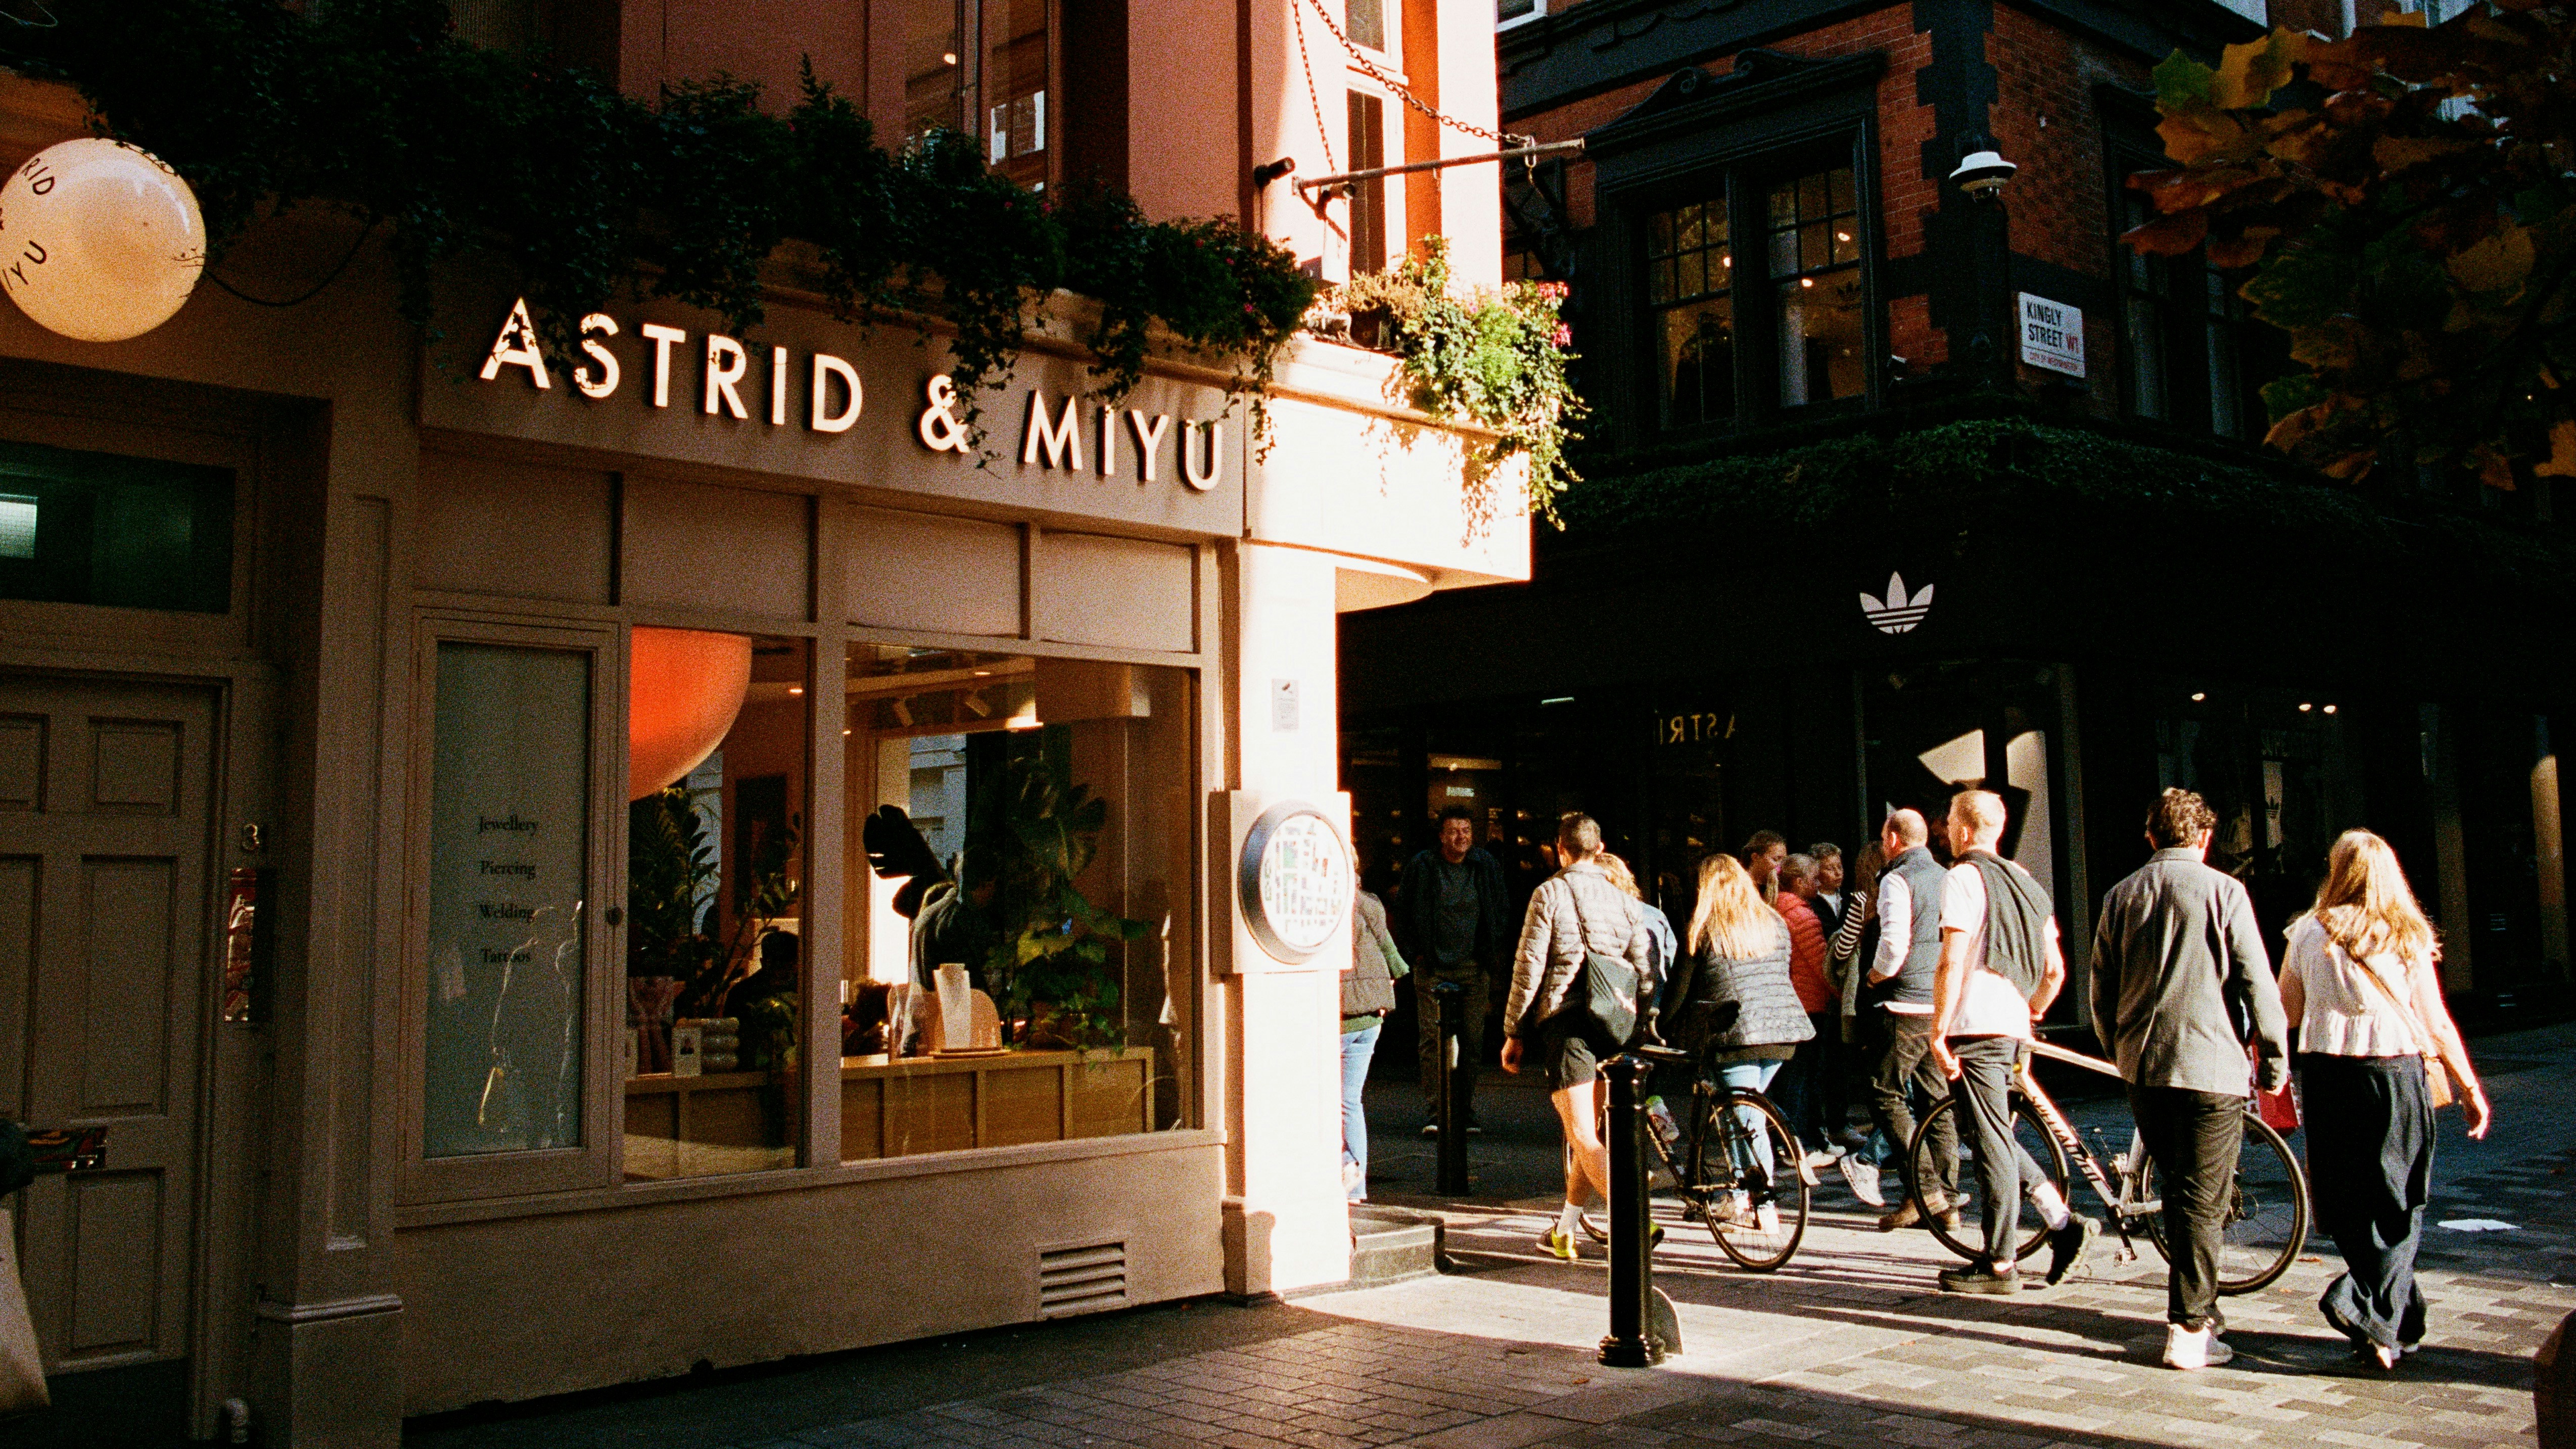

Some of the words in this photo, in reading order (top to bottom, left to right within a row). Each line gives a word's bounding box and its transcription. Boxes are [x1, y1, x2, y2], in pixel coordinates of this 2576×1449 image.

[2027, 302, 2061, 326] KINGLY
[2028, 323, 2063, 349] STREET
[2066, 334, 2080, 354] W1
[480, 297, 863, 433] ASTRID
[918, 373, 970, 453] &
[1020, 389, 1223, 492] MIYU
[242, 822, 260, 851] 3
[478, 814, 539, 836] Jewellery
[480, 861, 536, 880] Piercing
[479, 904, 536, 923] Welding
